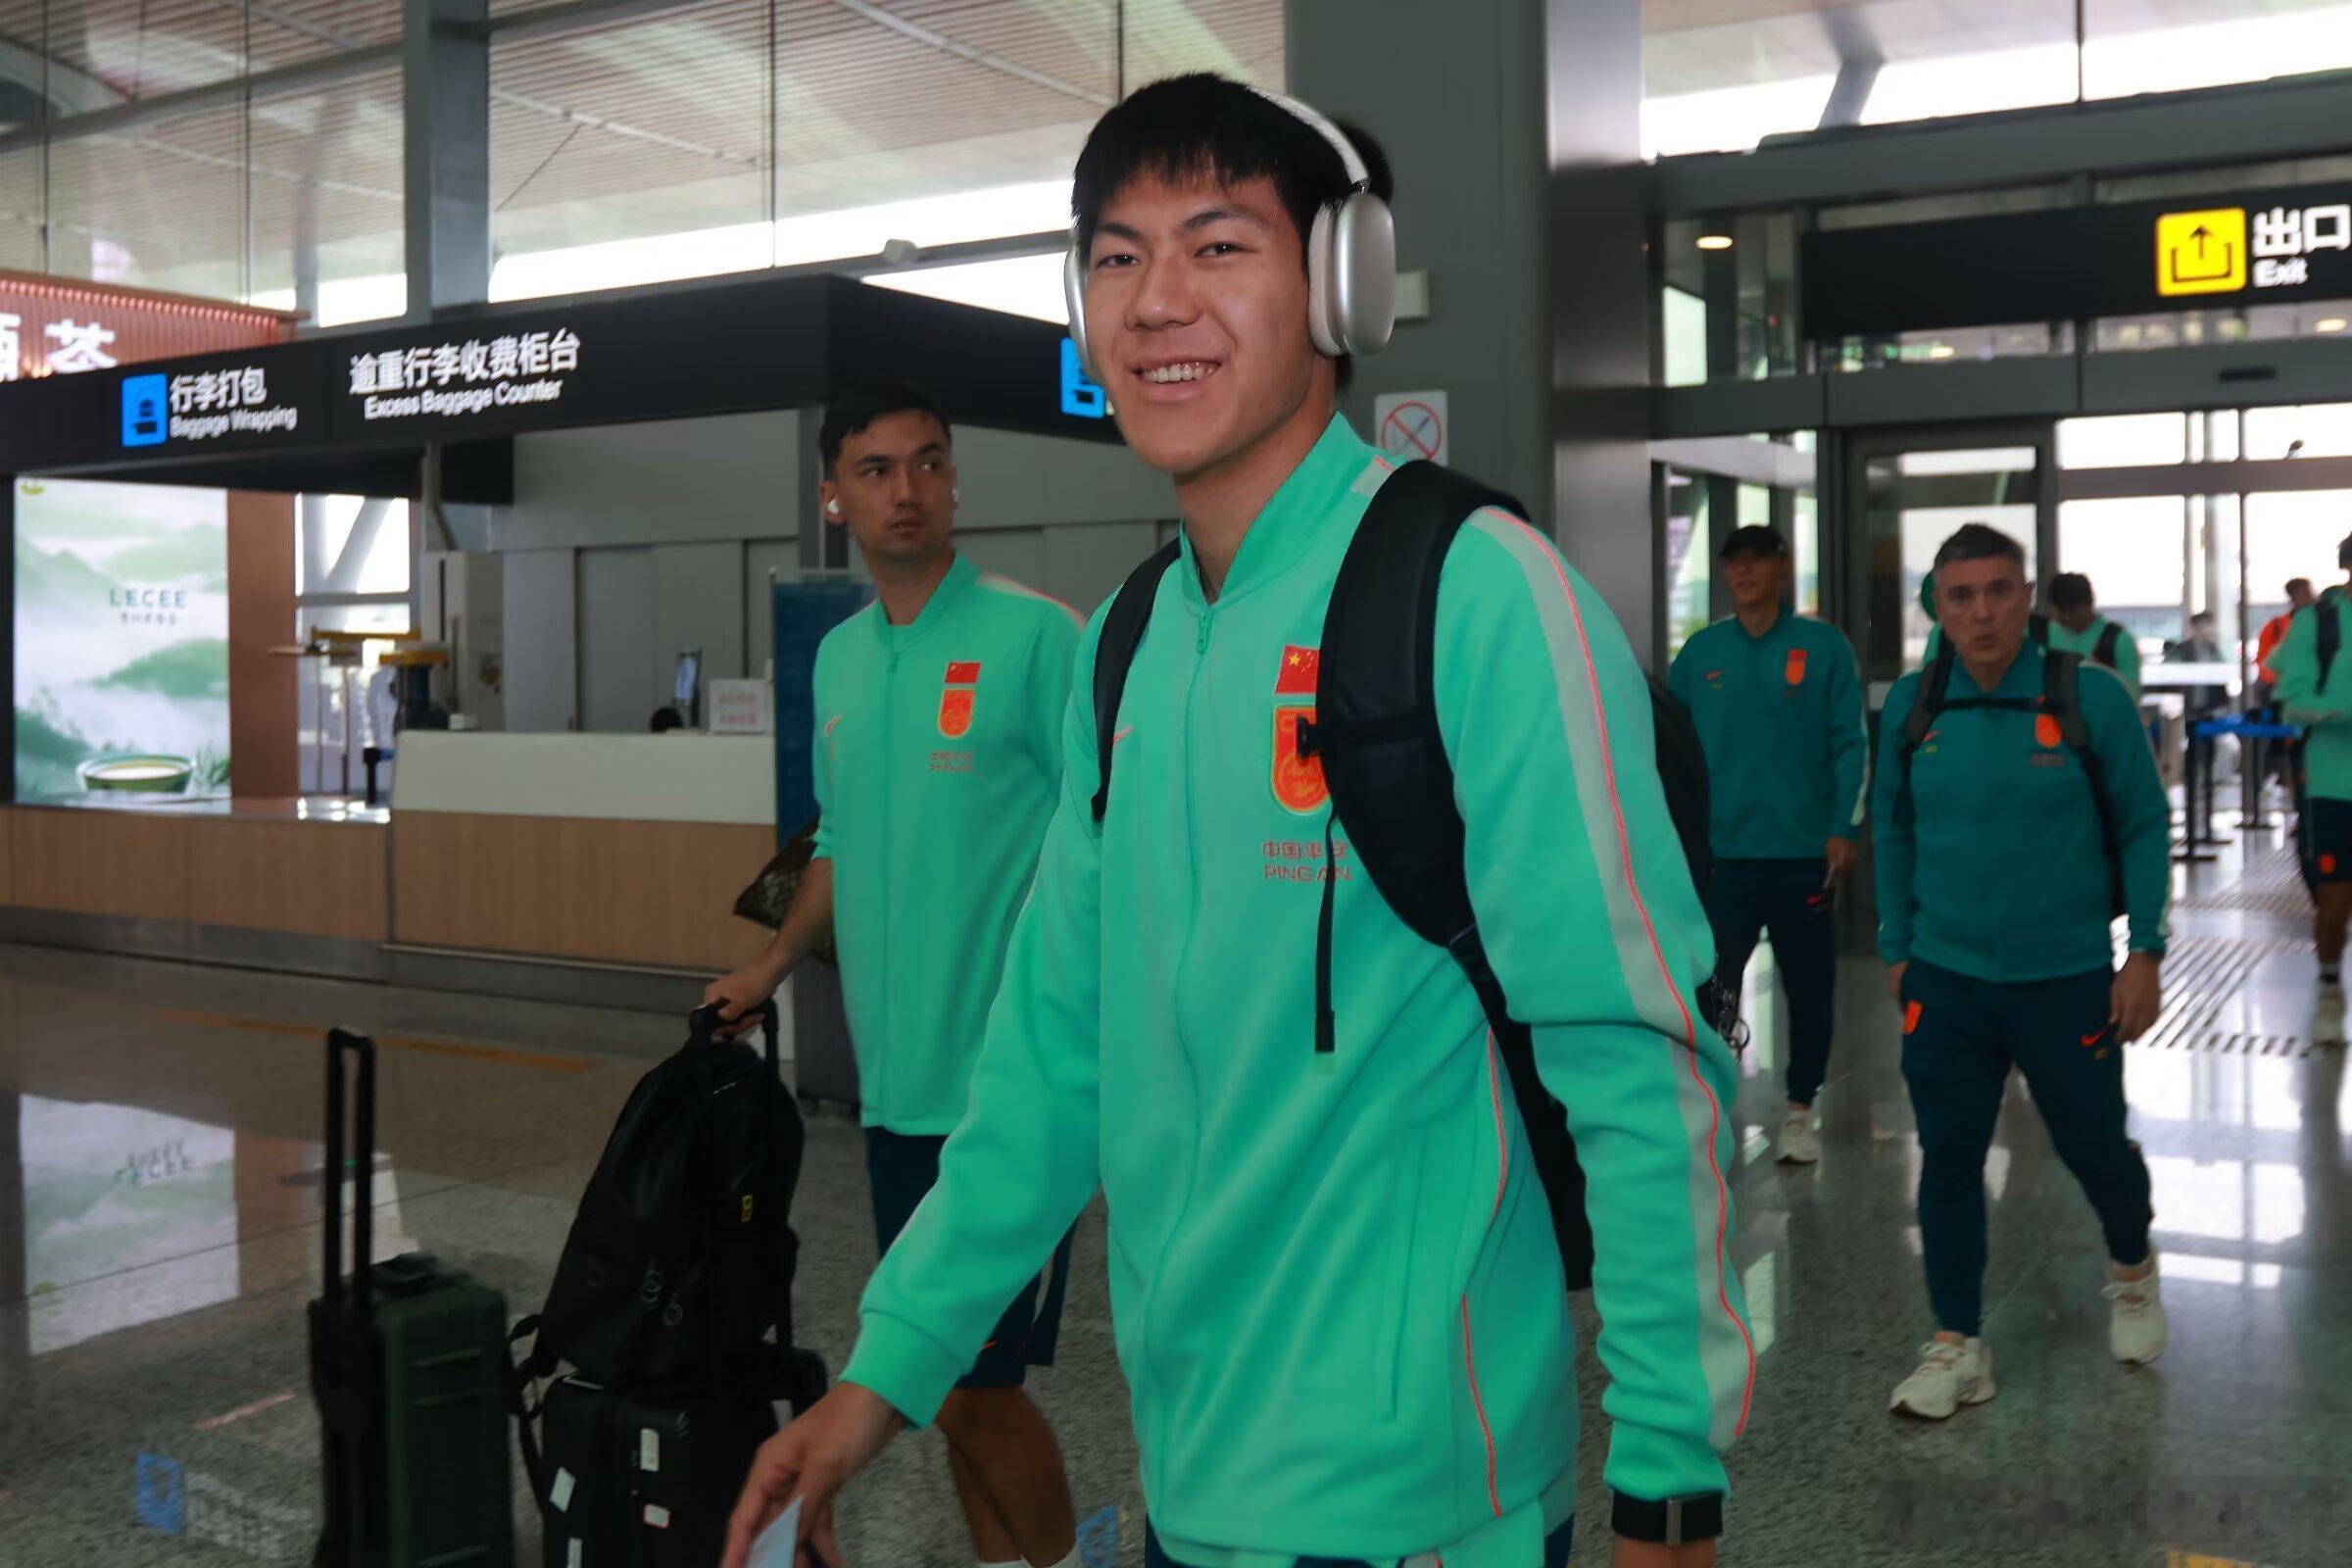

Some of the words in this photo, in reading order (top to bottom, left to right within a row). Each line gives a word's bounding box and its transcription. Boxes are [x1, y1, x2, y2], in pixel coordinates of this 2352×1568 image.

[2252, 204, 2351, 257] 出口
[2253, 256, 2308, 287] Exit
[350, 327, 580, 395] 逾重行李收费柜台
[170, 367, 267, 414] 行李打包
[365, 393, 419, 420] Excess
[420, 388, 494, 416] Baggage
[493, 377, 564, 406] Counter
[110, 589, 187, 608] LECEE
